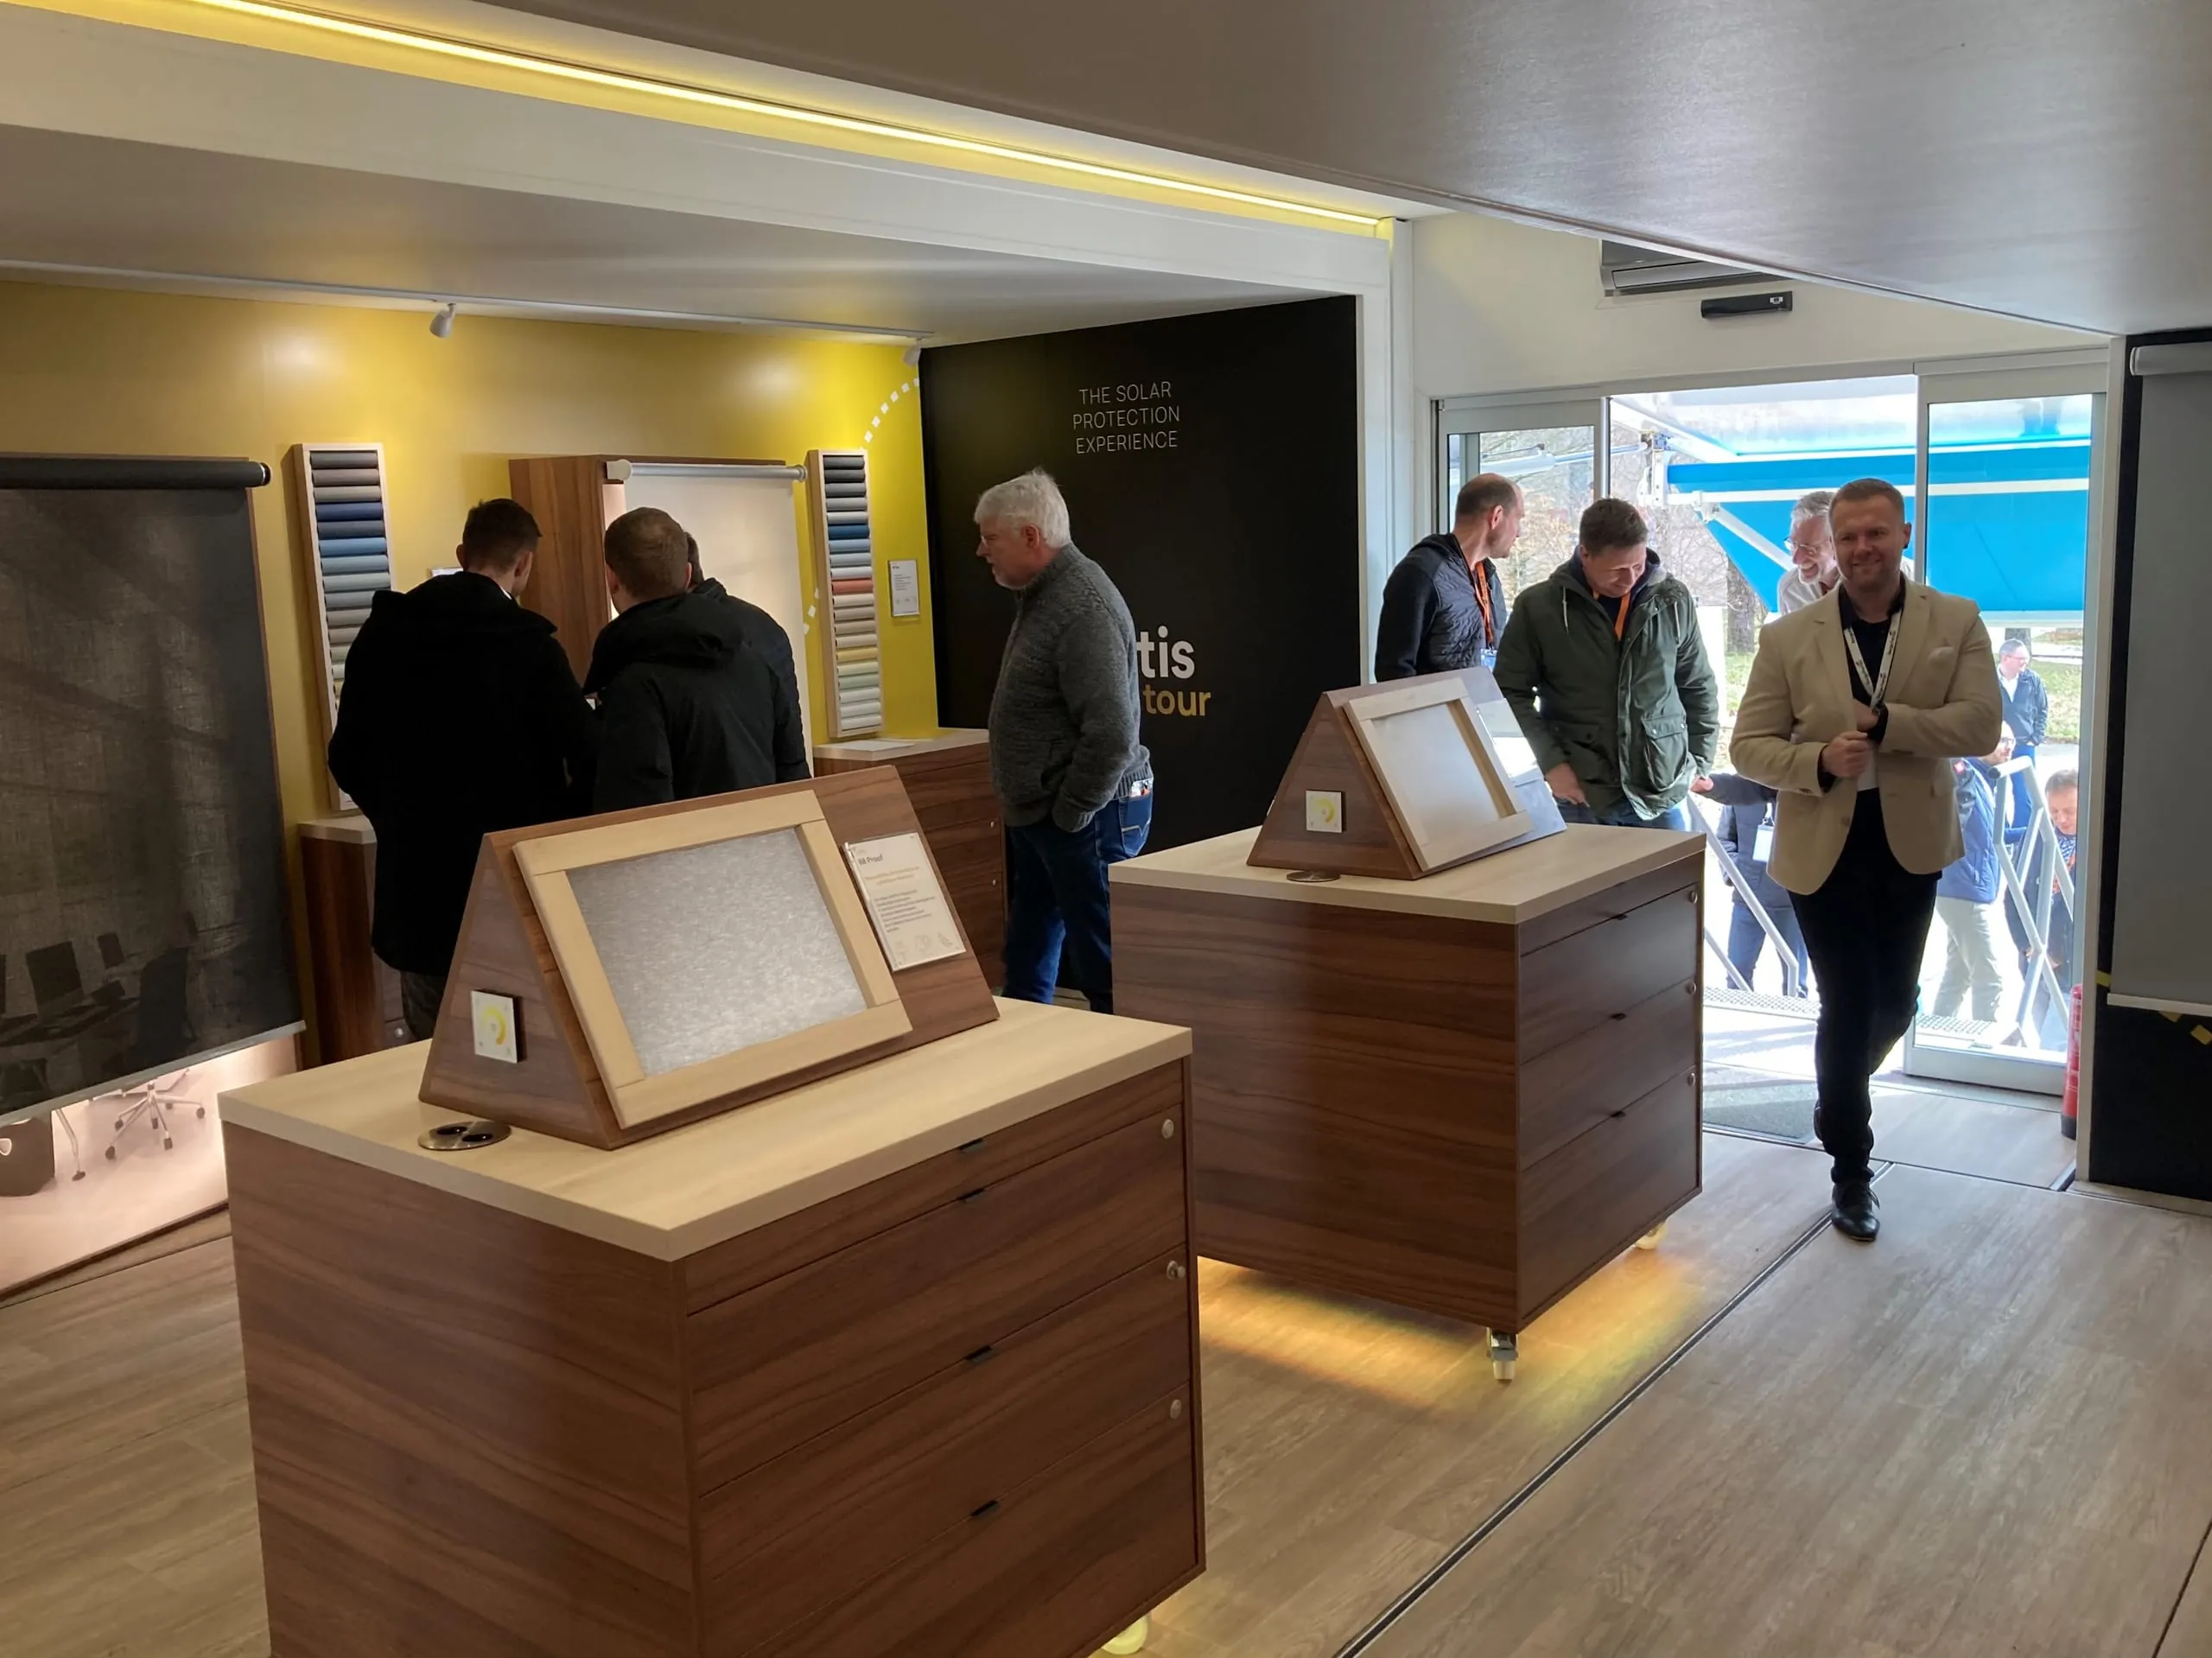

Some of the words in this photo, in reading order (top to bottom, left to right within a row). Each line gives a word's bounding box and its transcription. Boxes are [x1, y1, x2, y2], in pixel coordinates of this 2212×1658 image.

[1078, 387, 1111, 405] THE
[1116, 381, 1173, 403] SOLAR
[1072, 405, 1180, 430] PROTECTION
[1076, 430, 1179, 454] EXPERIENCE
[1136, 625, 1195, 679] tis
[1142, 683, 1211, 716] tour
[867, 854, 883, 863] Proof
